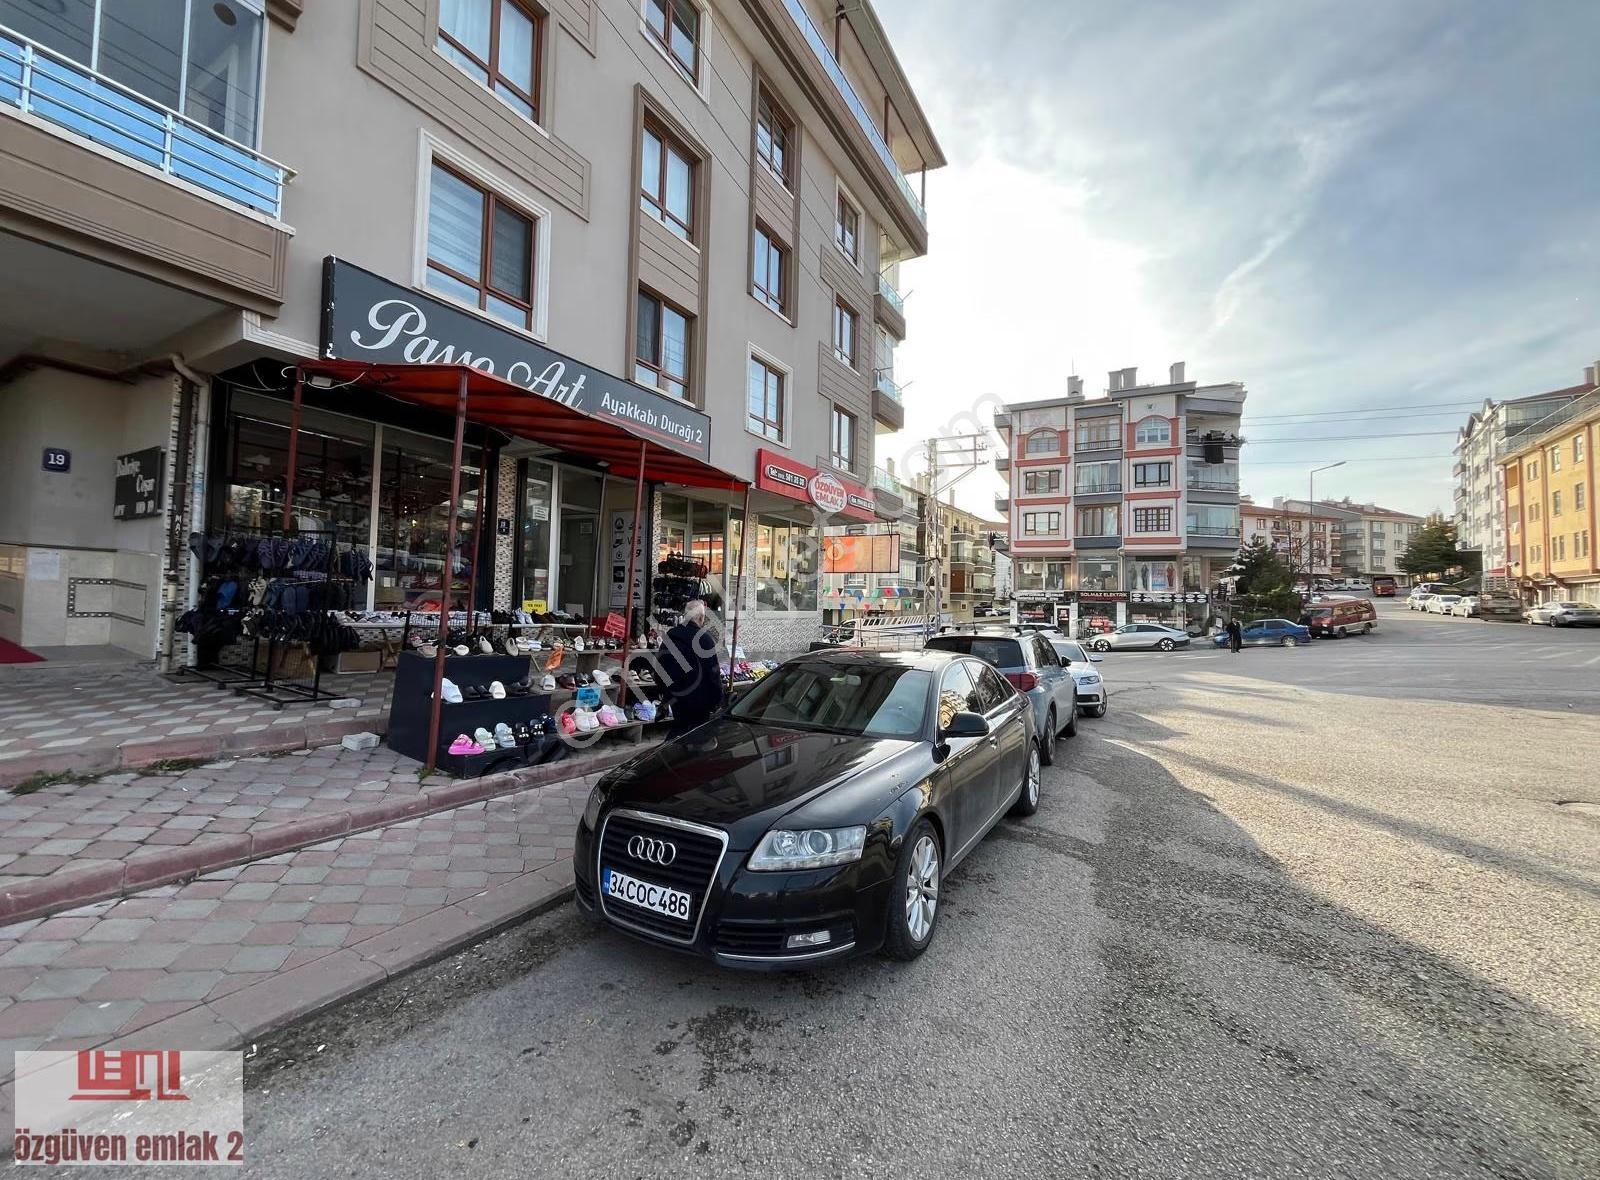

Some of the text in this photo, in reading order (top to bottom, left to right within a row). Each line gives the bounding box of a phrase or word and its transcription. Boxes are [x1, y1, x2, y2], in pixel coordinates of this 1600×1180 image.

[507, 361, 588, 409] Art
[601, 392, 703, 444] Ayakkabı Durağı 2
[48, 453, 65, 466] 19
[815, 491, 838, 506] EMLAK
